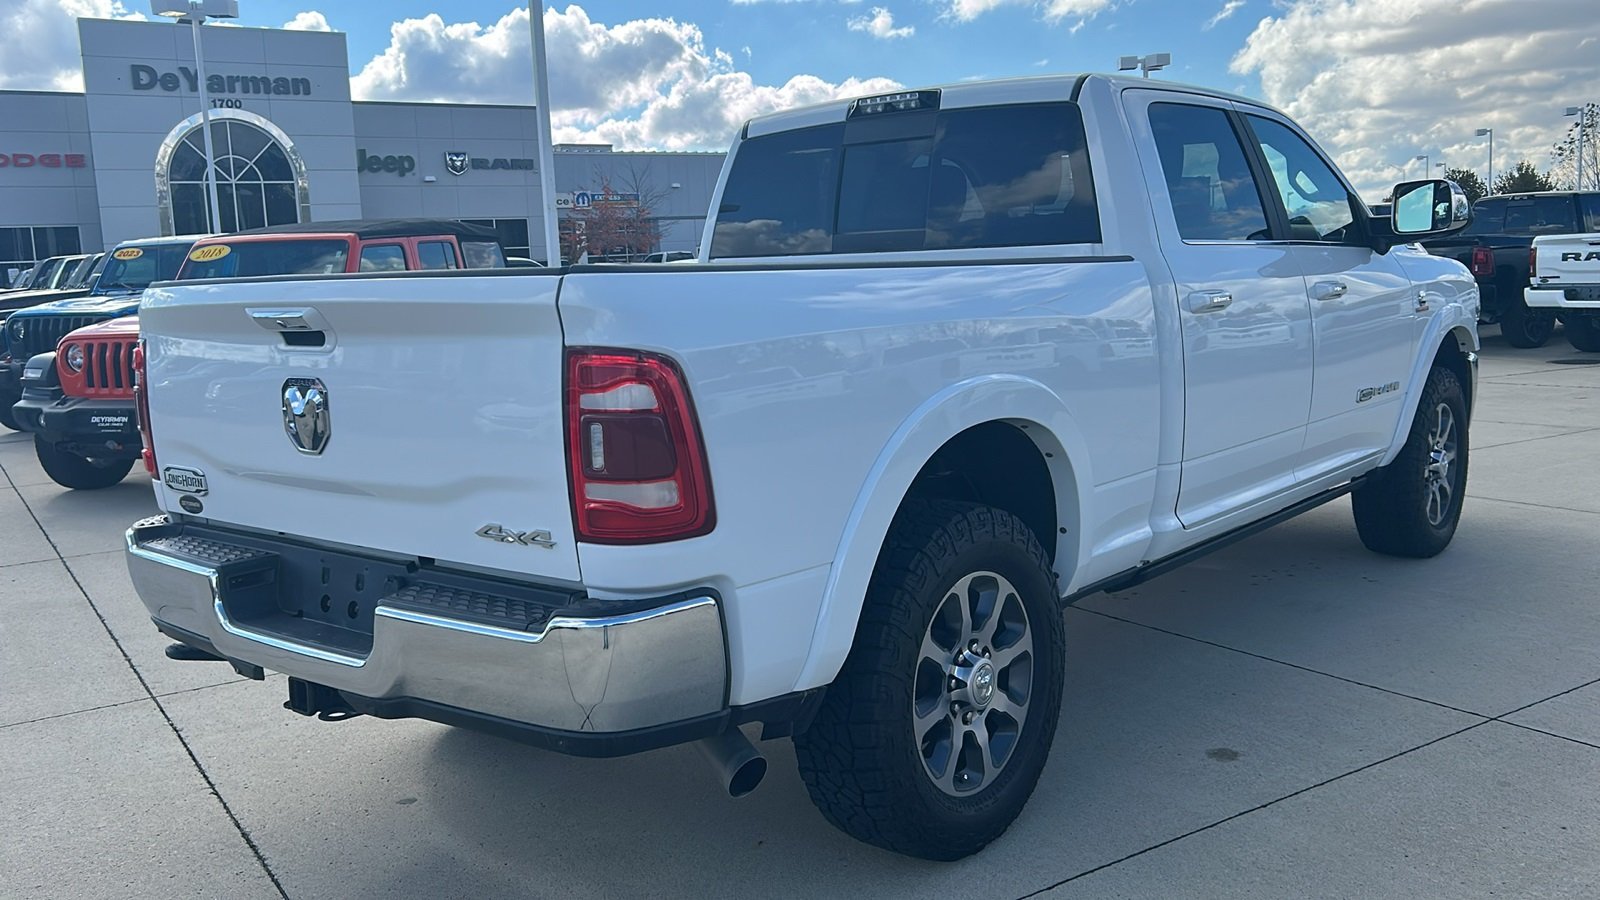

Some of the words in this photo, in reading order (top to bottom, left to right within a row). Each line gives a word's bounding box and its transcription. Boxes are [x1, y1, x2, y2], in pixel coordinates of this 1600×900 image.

[131, 64, 311, 96] DeYarman
[210, 99, 242, 109] 1700
[357, 149, 415, 177] Jeep
[471, 158, 534, 170] RAM
[196, 247, 225, 260] 2018
